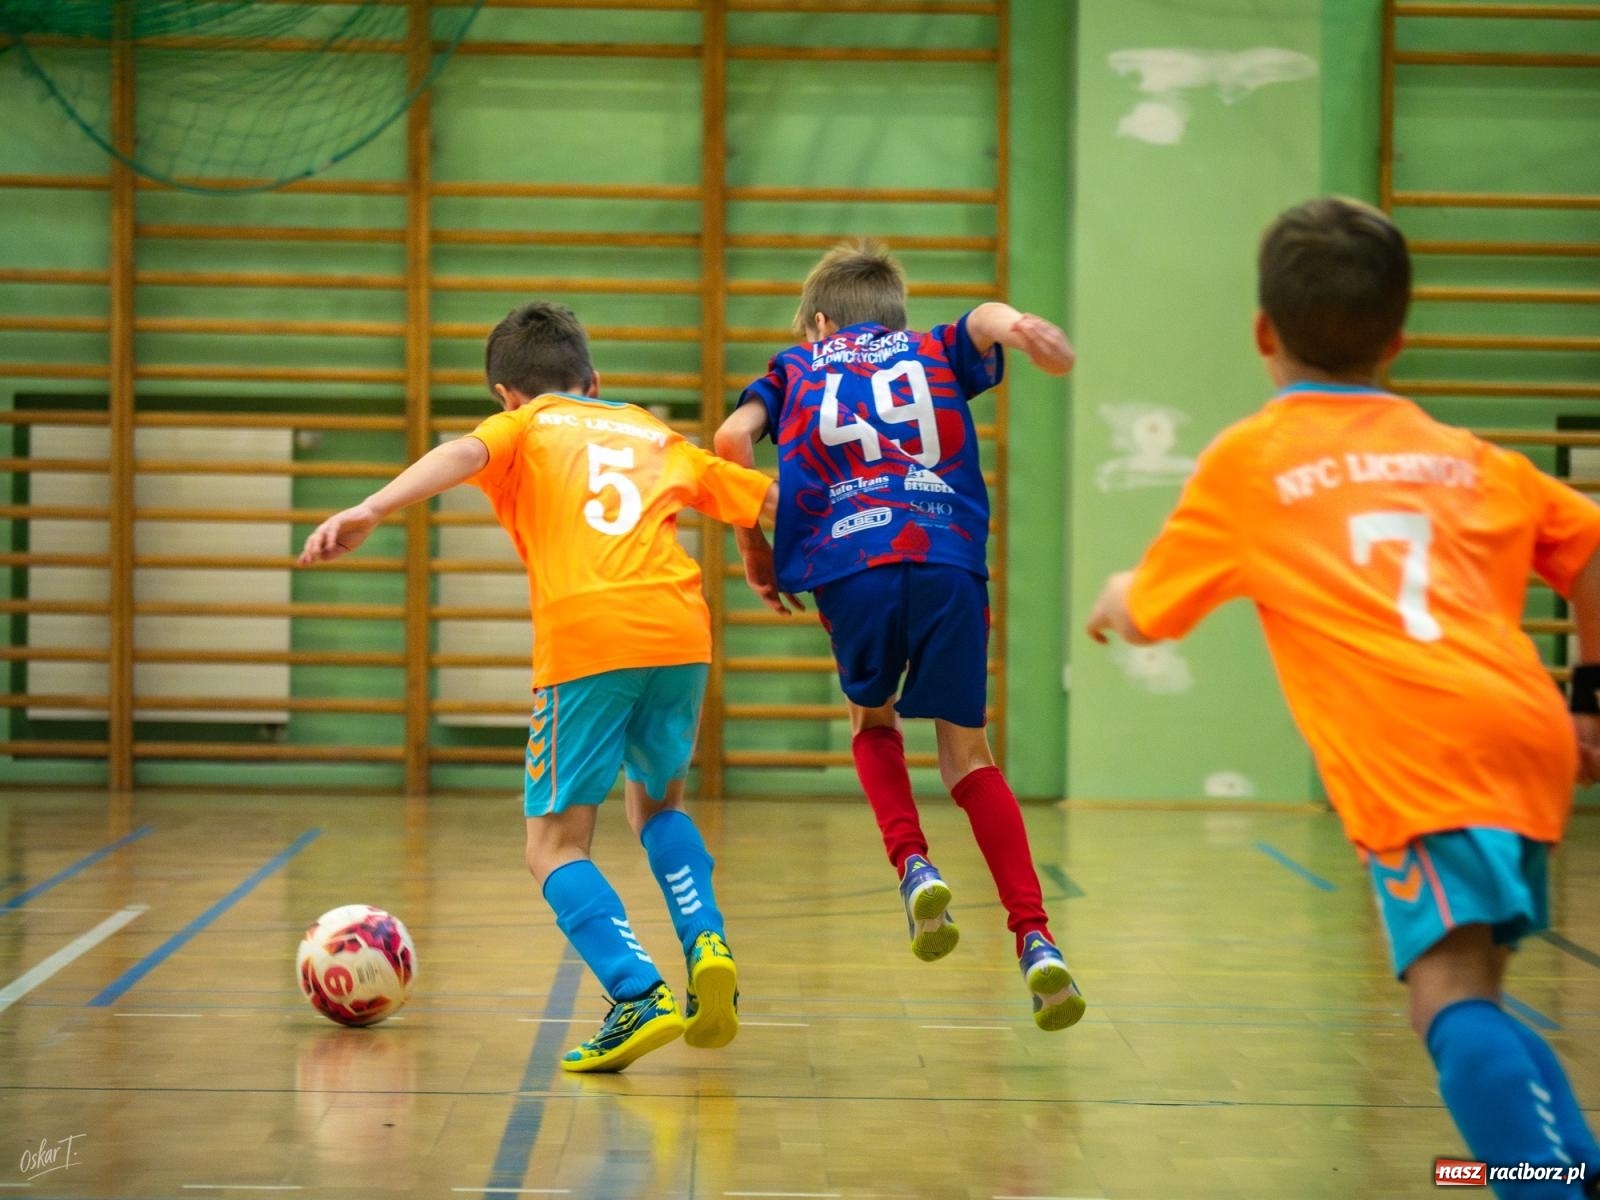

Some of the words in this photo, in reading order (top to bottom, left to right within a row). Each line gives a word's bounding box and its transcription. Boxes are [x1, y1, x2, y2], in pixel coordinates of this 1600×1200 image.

[812, 336, 848, 360] LKS
[855, 331, 909, 352] BSKID
[818, 360, 941, 469] 49
[584, 442, 642, 536] 5
[829, 475, 889, 498] Auto-Trans
[1274, 457, 1341, 506] NFC
[910, 499, 953, 516] SOHO
[1348, 510, 1443, 642] 7
